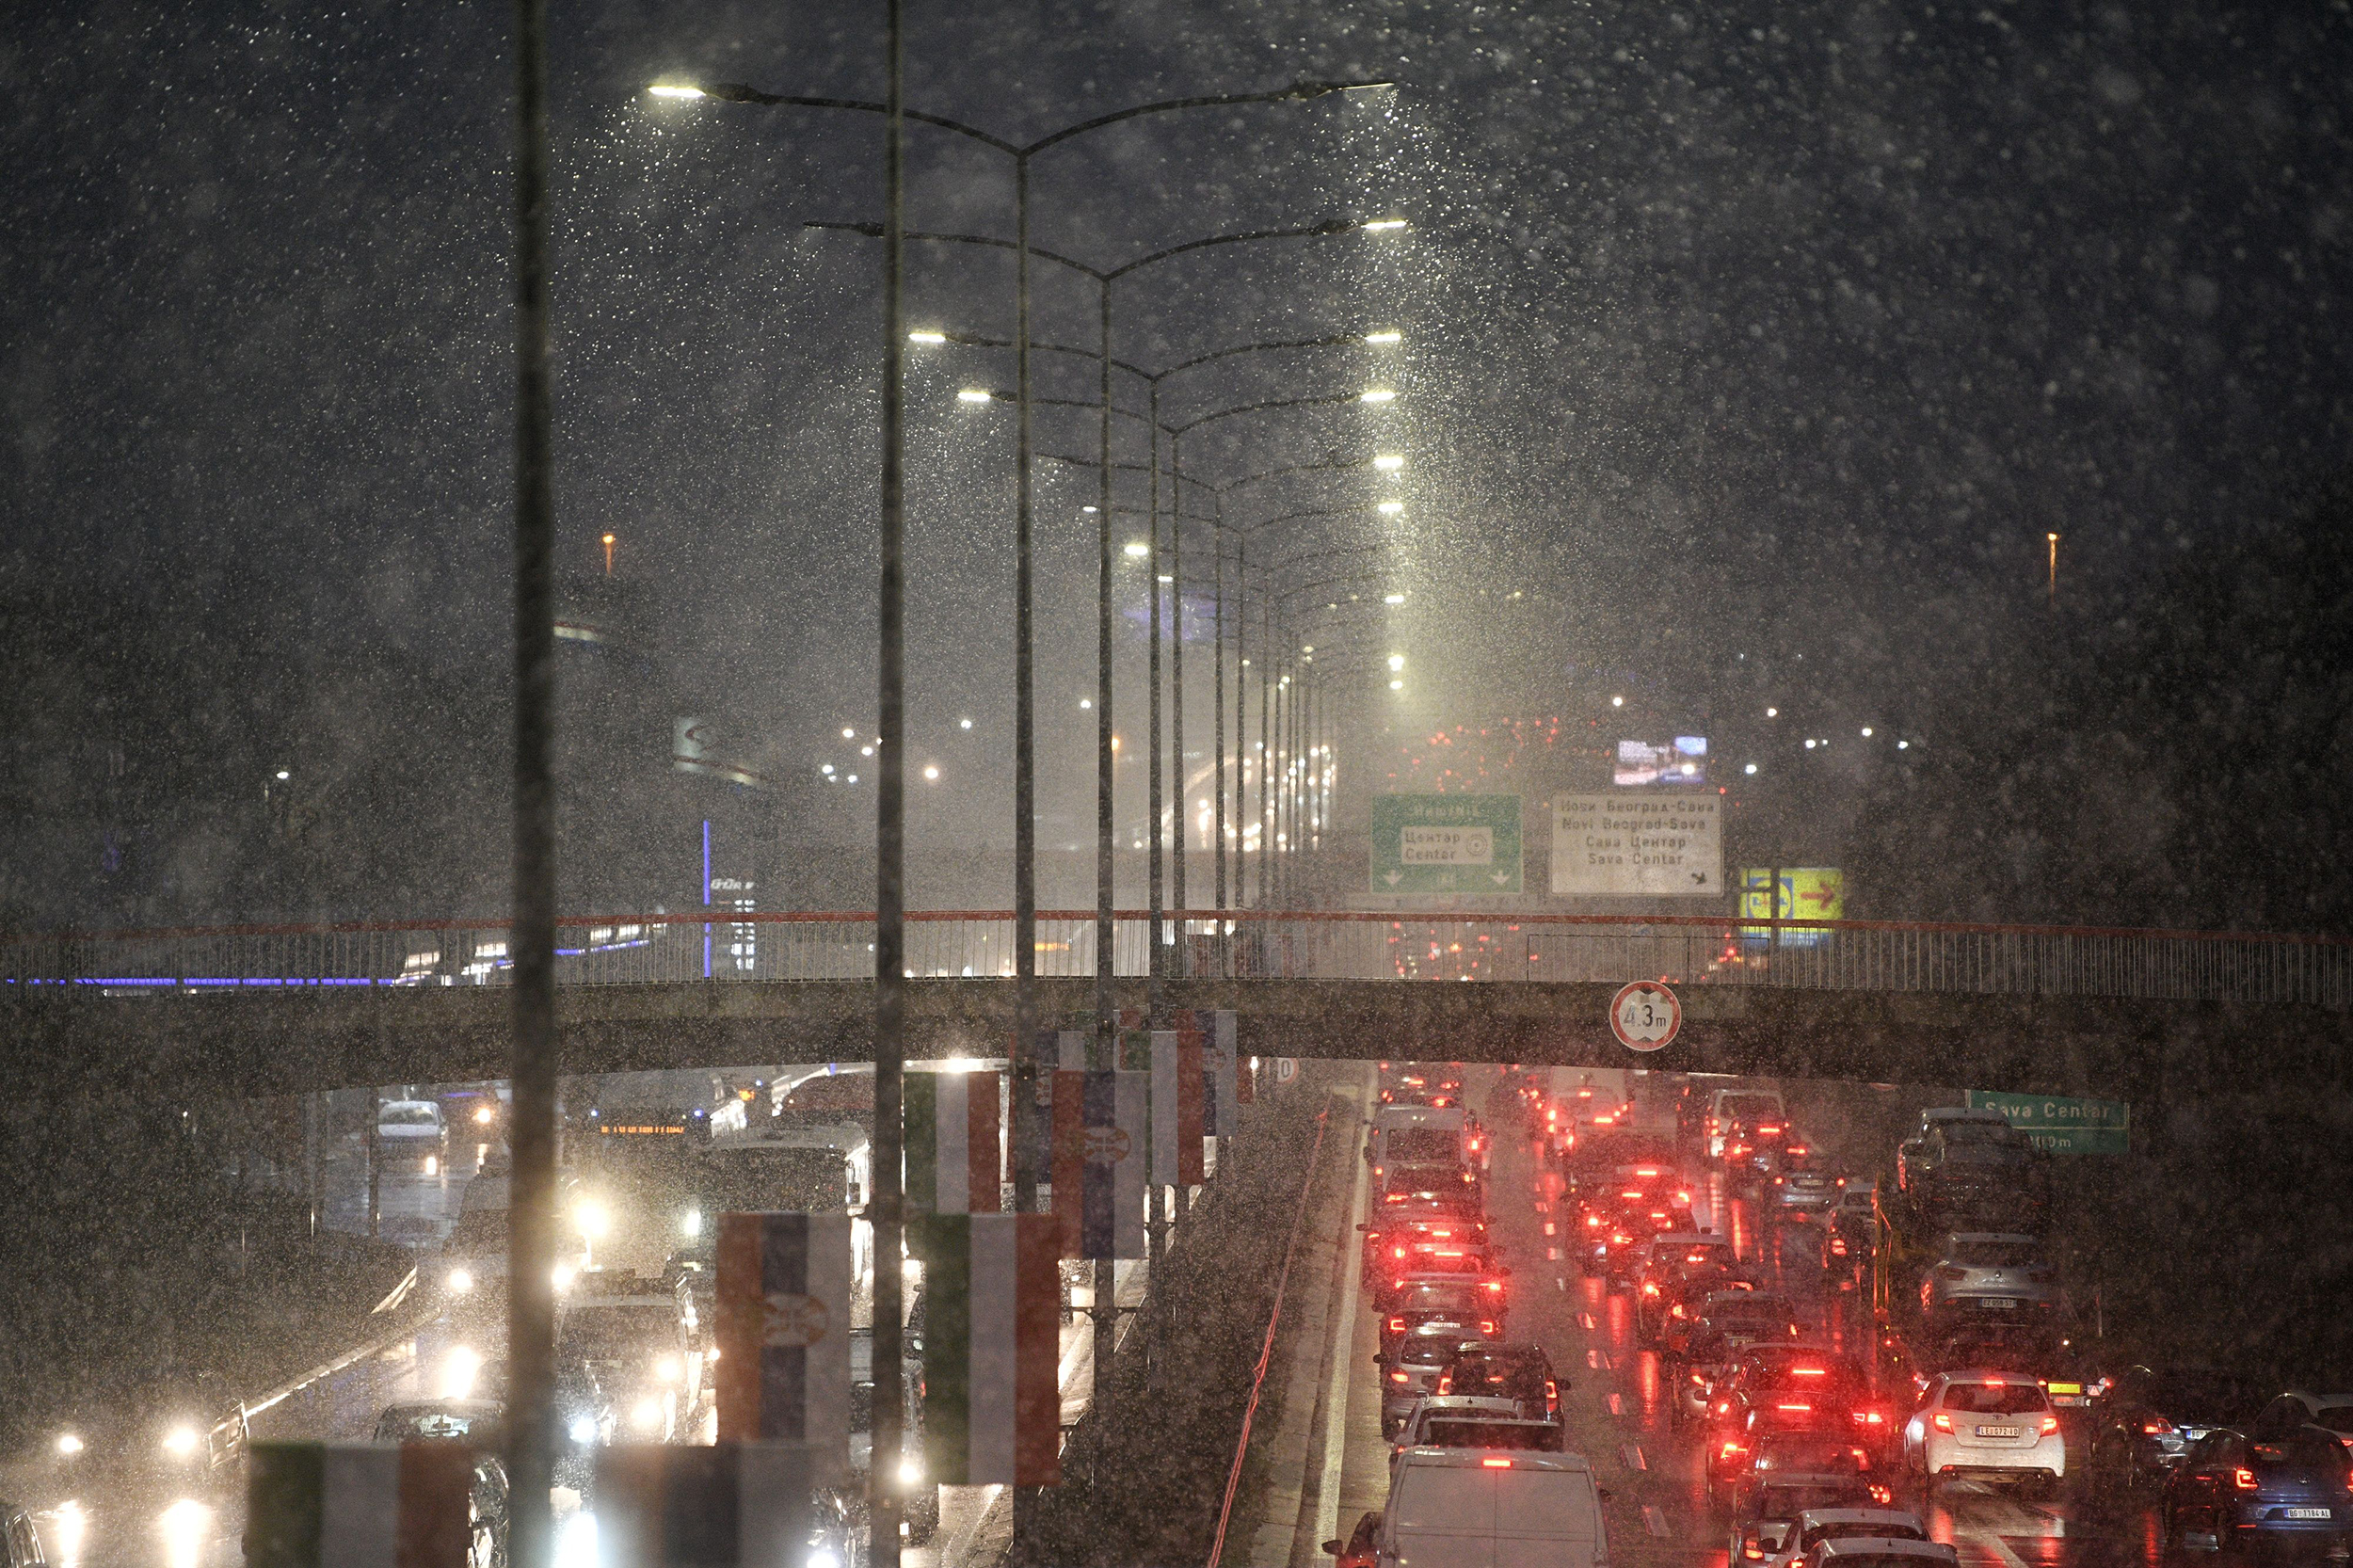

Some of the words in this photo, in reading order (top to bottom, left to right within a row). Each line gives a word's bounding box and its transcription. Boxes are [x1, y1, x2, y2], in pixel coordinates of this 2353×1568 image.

[1586, 835, 1621, 847] Сава
[1631, 836, 1687, 851] Центар
[1588, 853, 1624, 865] Sava
[1633, 853, 1684, 865] Centar
[1624, 1003, 1654, 1028] 4.3
[1657, 1016, 1667, 1028] m
[2043, 1101, 2109, 1118] Centar
